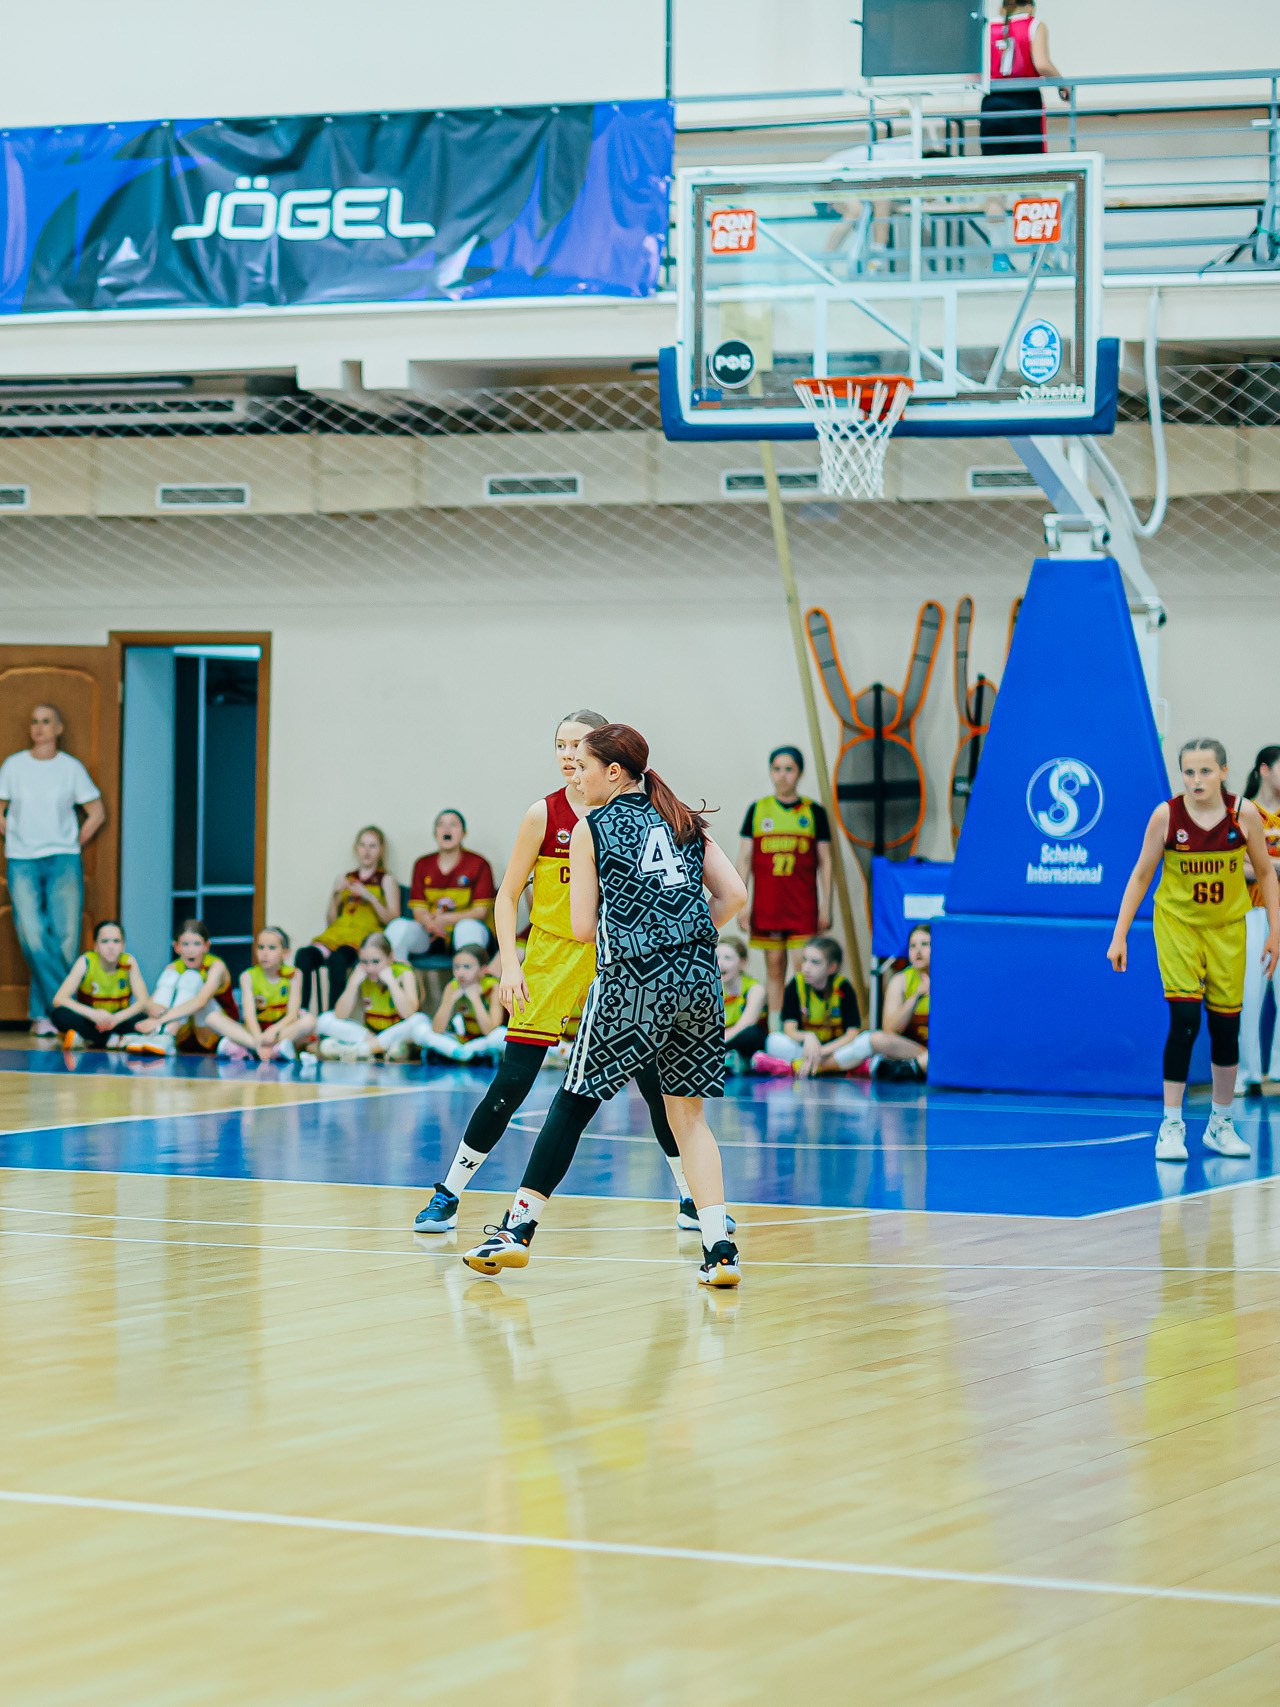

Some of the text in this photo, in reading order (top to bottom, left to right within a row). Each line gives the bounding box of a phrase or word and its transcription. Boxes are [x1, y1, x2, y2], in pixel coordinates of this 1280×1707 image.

[172, 176, 436, 241] JÖGEL
[1016, 202, 1058, 220] FON
[1017, 219, 1057, 239] BET
[637, 822, 691, 891] 4
[1040, 843, 1089, 864] Schelde
[1026, 862, 1103, 884] International
[1180, 859, 1225, 875] СШОР
[1193, 881, 1224, 904] 69
